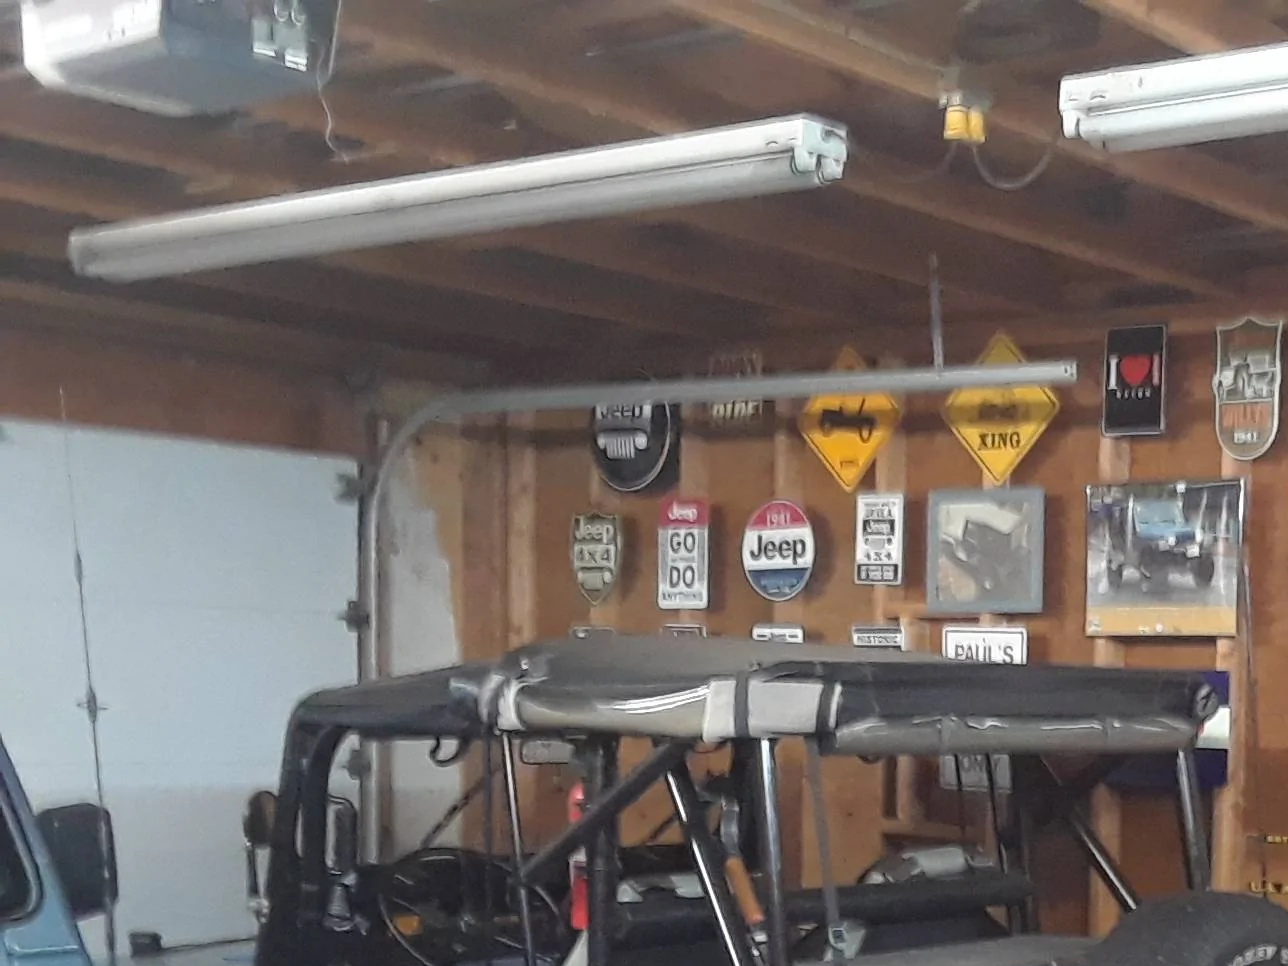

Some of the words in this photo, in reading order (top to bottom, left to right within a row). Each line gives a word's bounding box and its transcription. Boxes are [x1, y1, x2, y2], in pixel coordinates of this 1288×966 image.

[977, 432, 1021, 450] XING
[667, 501, 698, 522] Jeep
[766, 513, 792, 528] 1941
[575, 519, 615, 543] Jeep
[669, 531, 697, 555] GO
[749, 534, 807, 565] Jeep
[669, 564, 696, 588] DO
[954, 637, 1014, 664] PAUL'S
